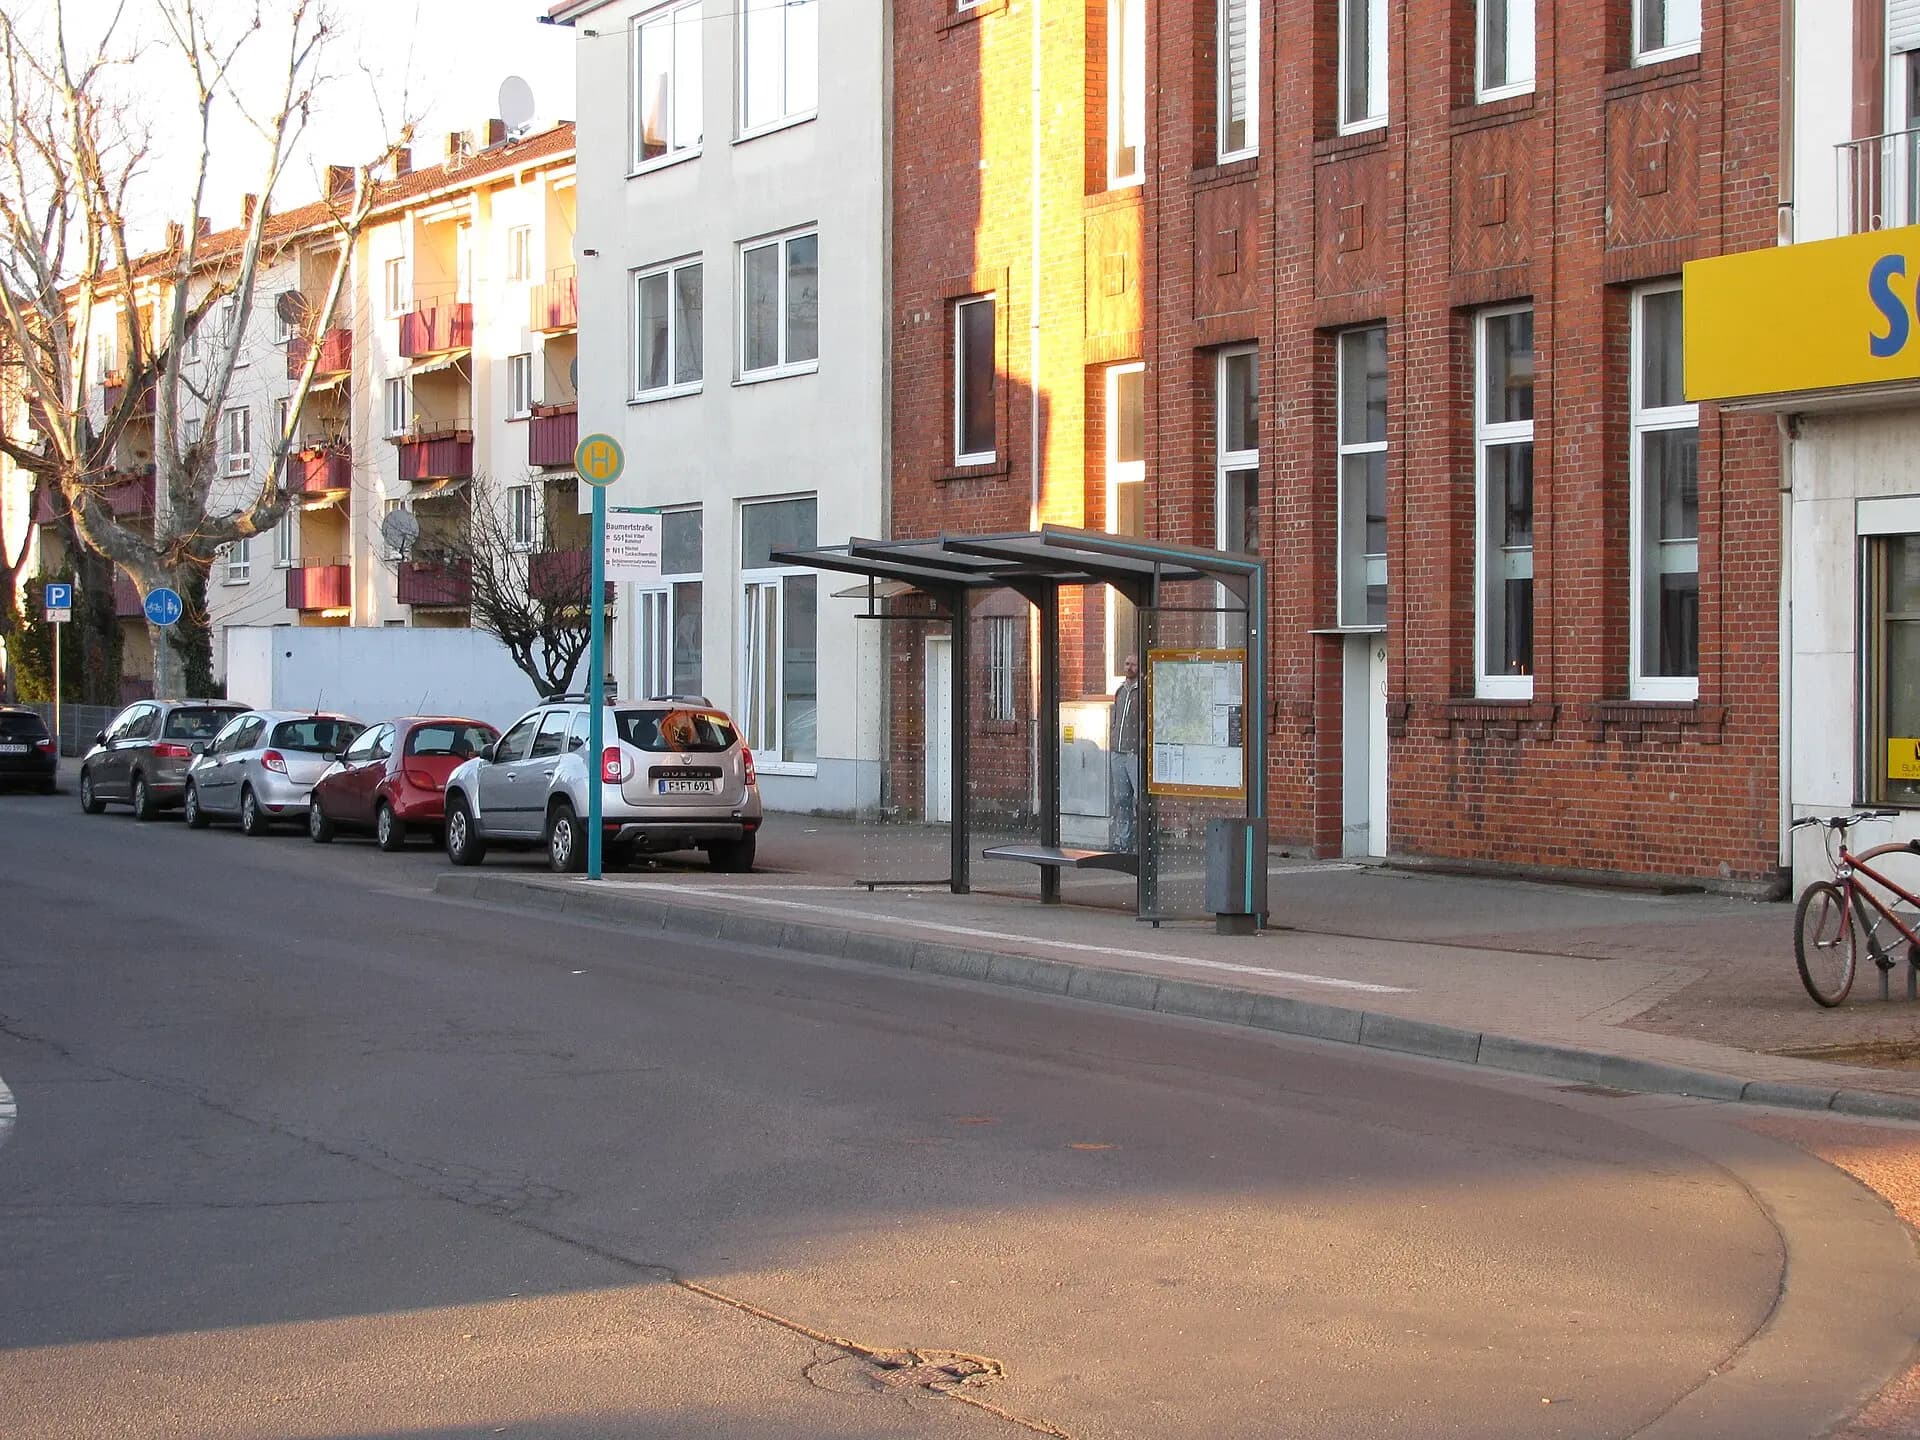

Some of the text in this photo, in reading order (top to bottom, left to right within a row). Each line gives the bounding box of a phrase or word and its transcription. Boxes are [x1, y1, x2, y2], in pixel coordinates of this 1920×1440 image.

[1868, 254, 1920, 358] S
[606, 522, 653, 532] Baumertstraße
[613, 534, 624, 542] 551
[612, 546, 624, 555] N11
[52, 587, 65, 605] P
